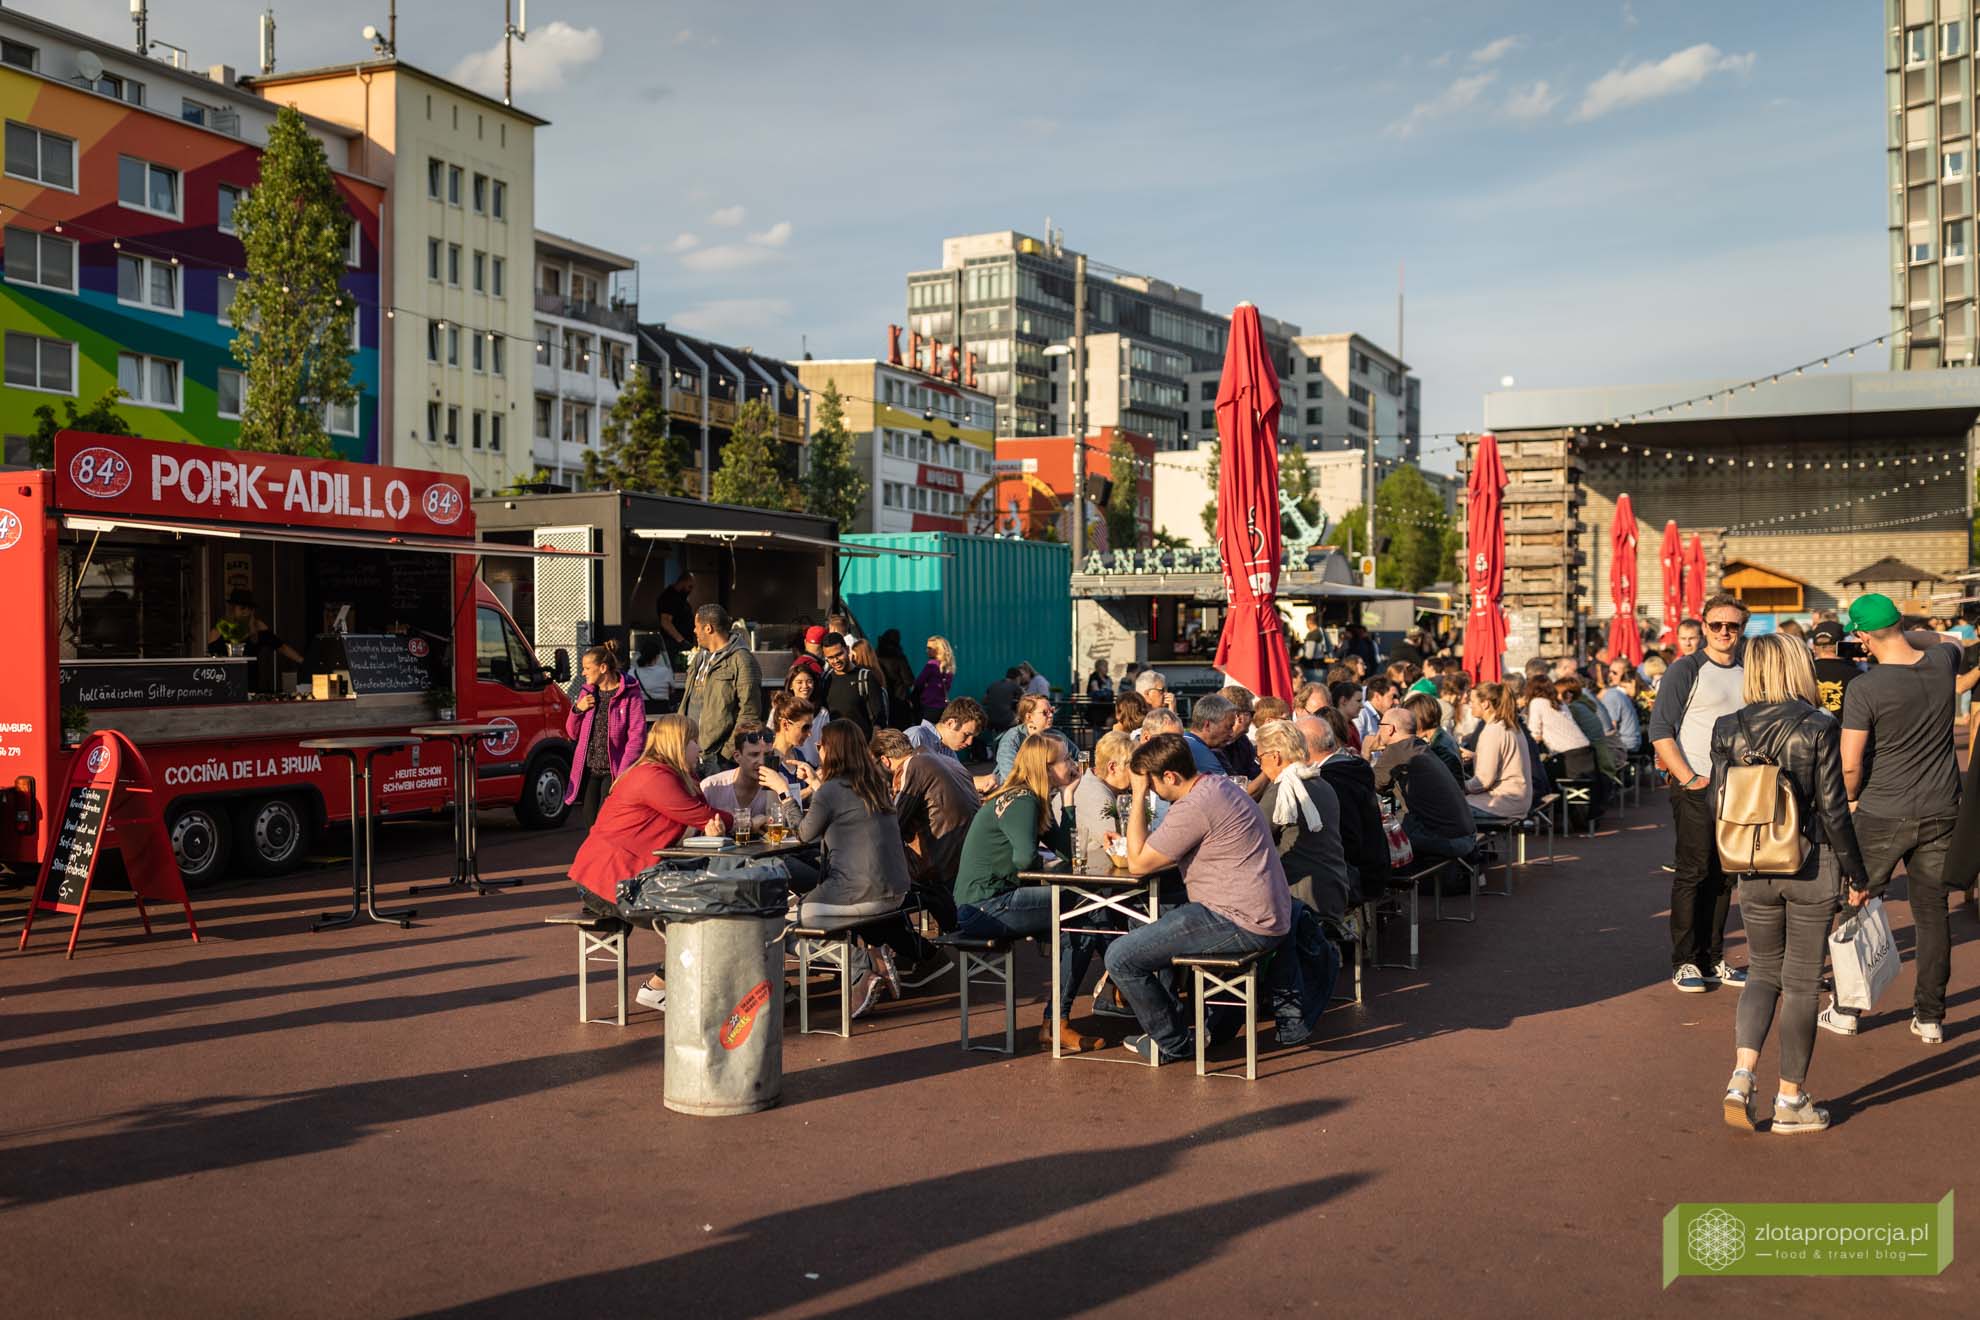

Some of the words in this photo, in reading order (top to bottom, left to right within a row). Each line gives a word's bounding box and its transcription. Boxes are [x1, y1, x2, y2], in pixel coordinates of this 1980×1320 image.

[78, 455, 125, 485] 84°
[151, 454, 411, 520] PORK-ADILLO
[427, 489, 458, 514] 84°
[164, 757, 229, 785] COCIÑA
[232, 760, 253, 779] DE
[256, 758, 278, 777] LA
[395, 768, 417, 779] HEUTE
[383, 780, 415, 793] SCHWEIN
[416, 778, 442, 789] GEHABT
